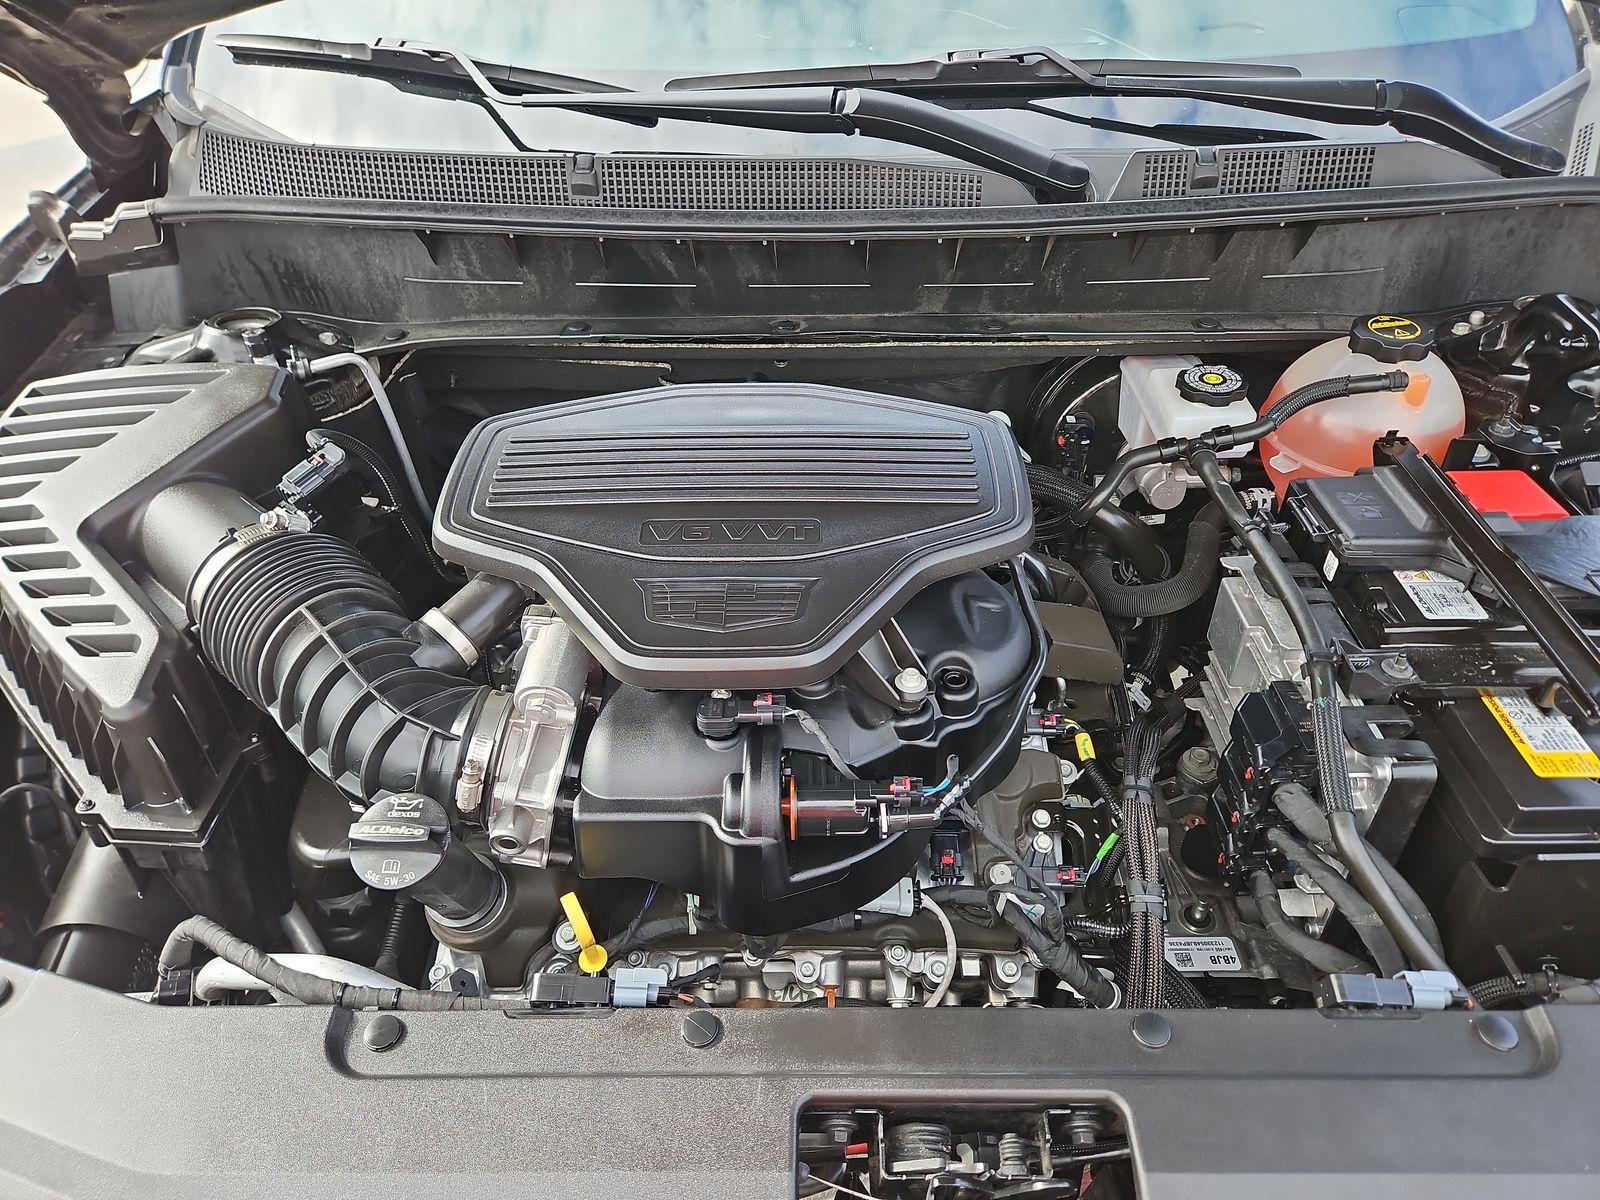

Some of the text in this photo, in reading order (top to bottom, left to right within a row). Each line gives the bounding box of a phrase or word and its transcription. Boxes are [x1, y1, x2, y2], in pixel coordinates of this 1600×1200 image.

[649, 523, 814, 541] V6 VVT
[387, 809, 421, 818] dexos
[358, 824, 425, 836] ACDelco
[364, 869, 416, 887] SAE 5W-30
[1209, 955, 1237, 965] 4BJB
